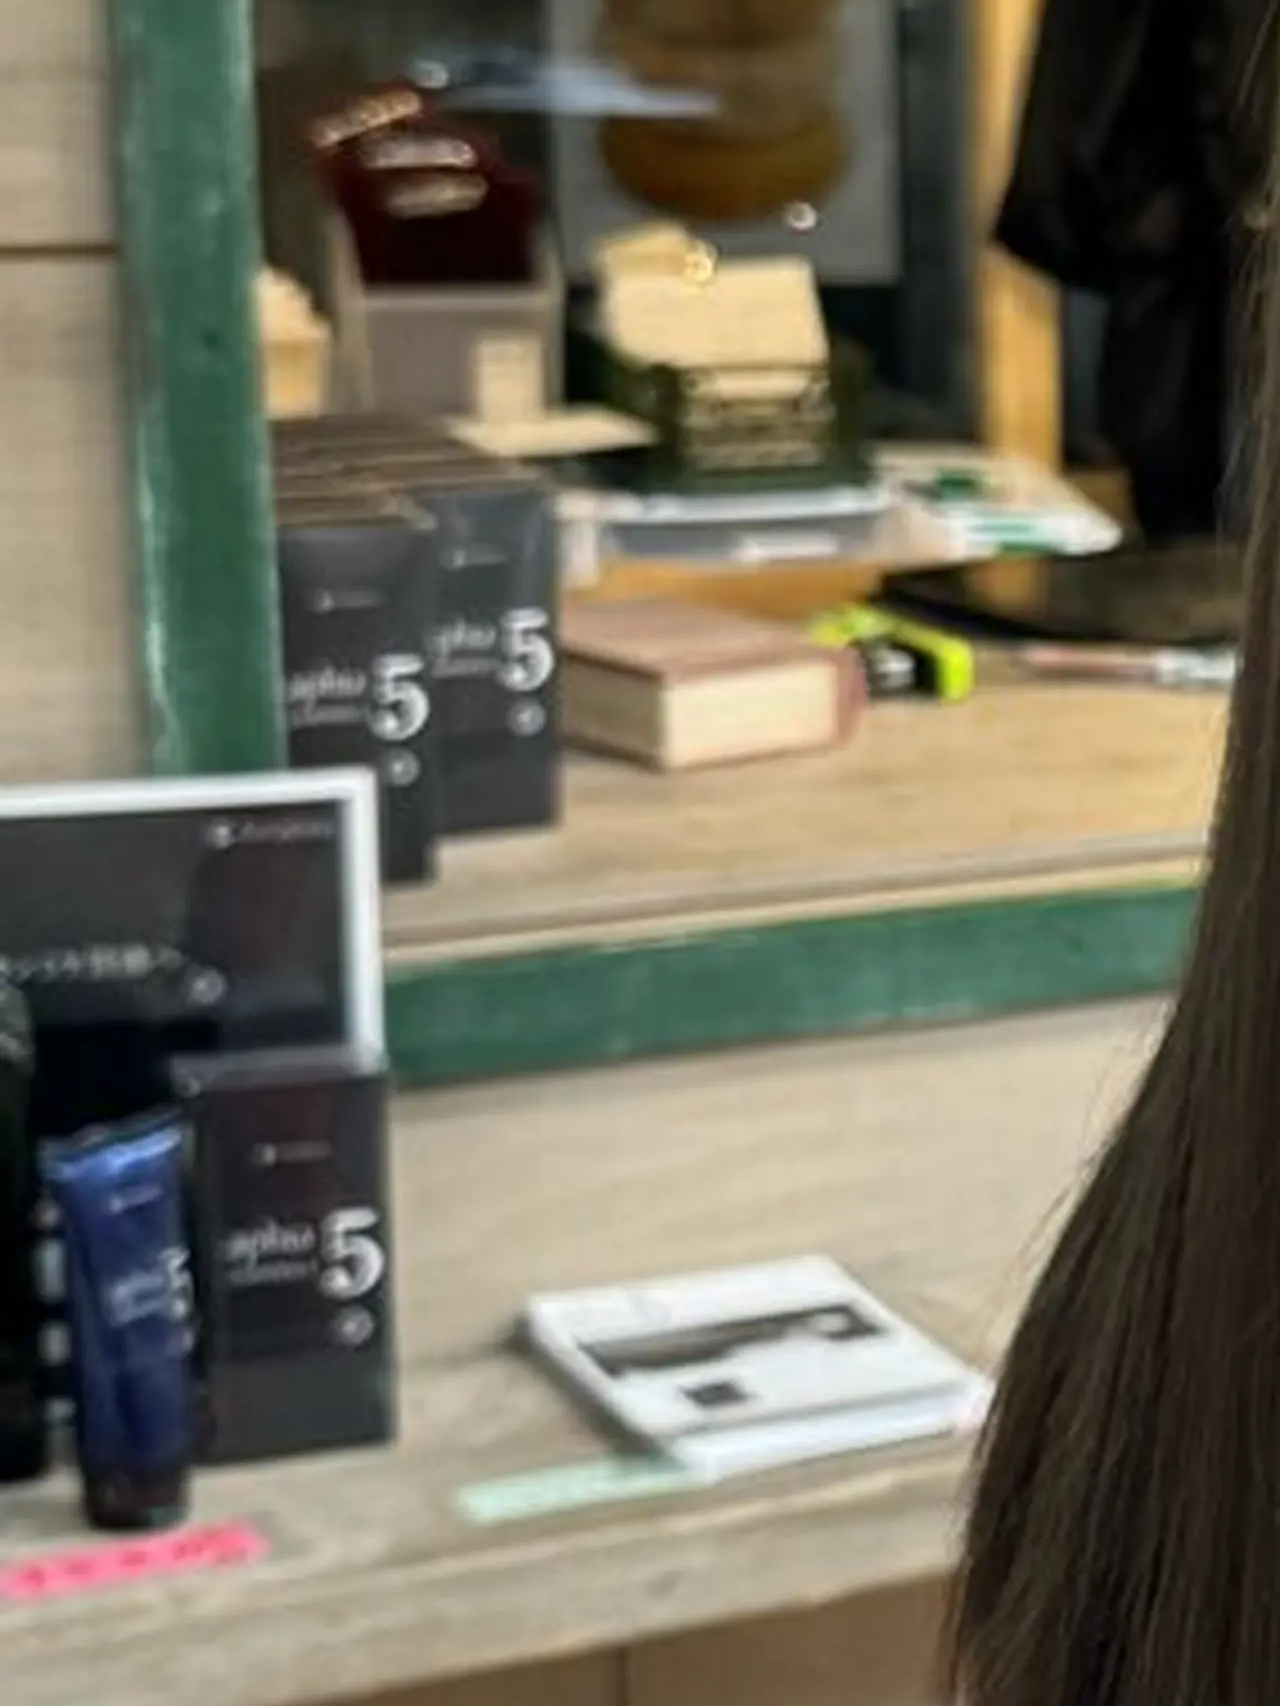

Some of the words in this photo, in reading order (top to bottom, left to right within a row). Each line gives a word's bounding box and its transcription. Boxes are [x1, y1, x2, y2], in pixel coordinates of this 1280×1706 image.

[500, 607, 555, 692] 5
[369, 652, 430, 741] 5
[320, 1206, 386, 1298] 5
